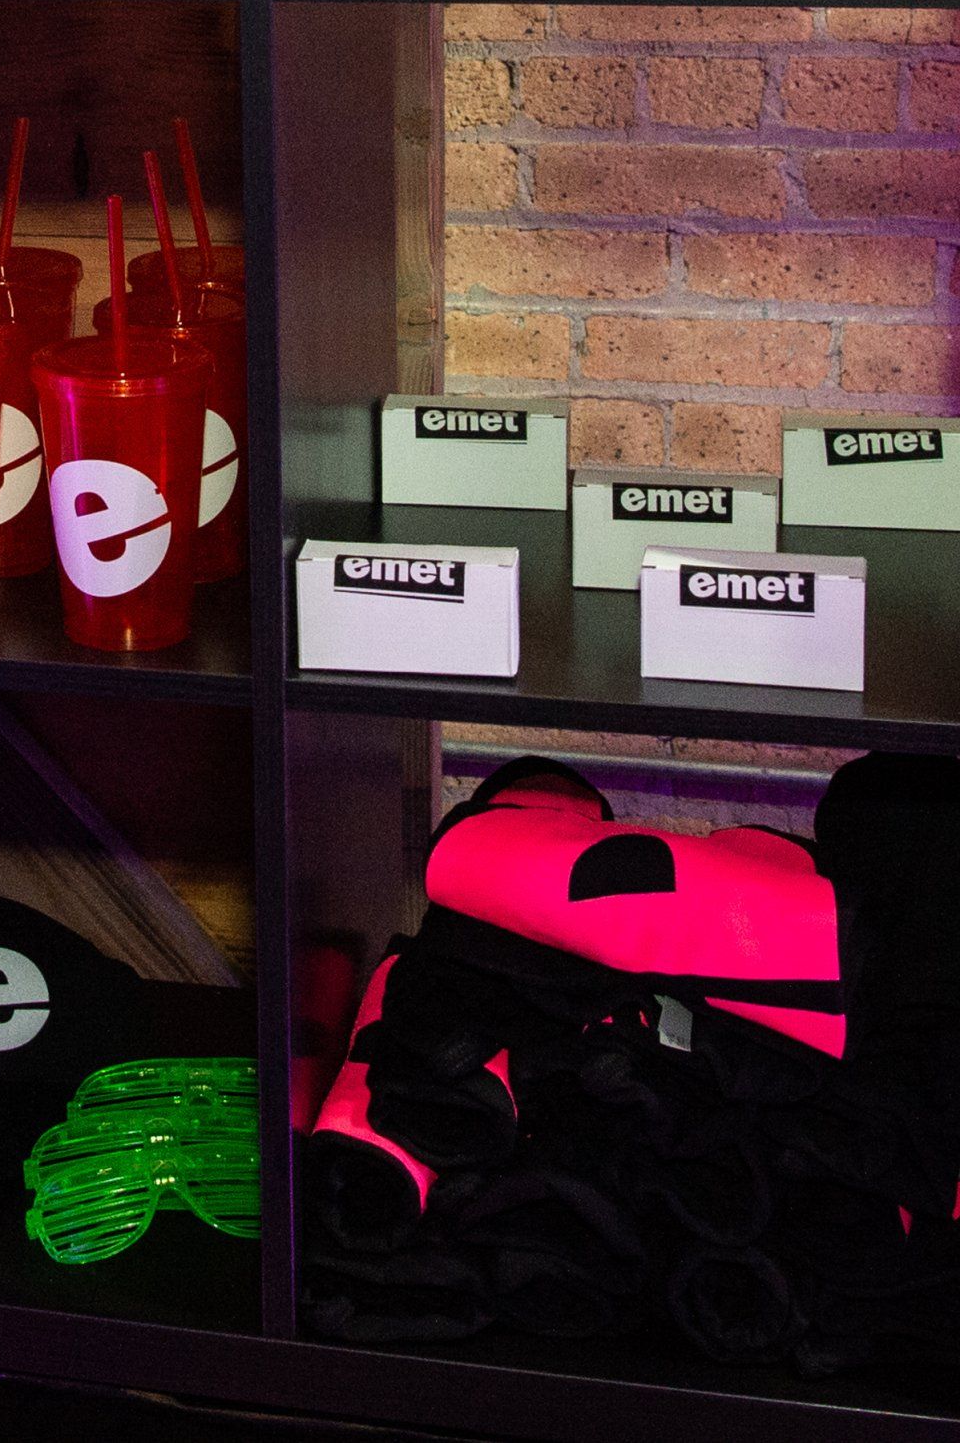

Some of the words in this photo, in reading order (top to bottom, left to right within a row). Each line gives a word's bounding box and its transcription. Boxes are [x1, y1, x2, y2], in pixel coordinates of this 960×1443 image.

[422, 409, 519, 432] emet
[833, 430, 936, 457] emet
[621, 485, 728, 515] emet
[50, 460, 172, 598] e
[343, 557, 455, 586] emet
[688, 570, 805, 604] emet
